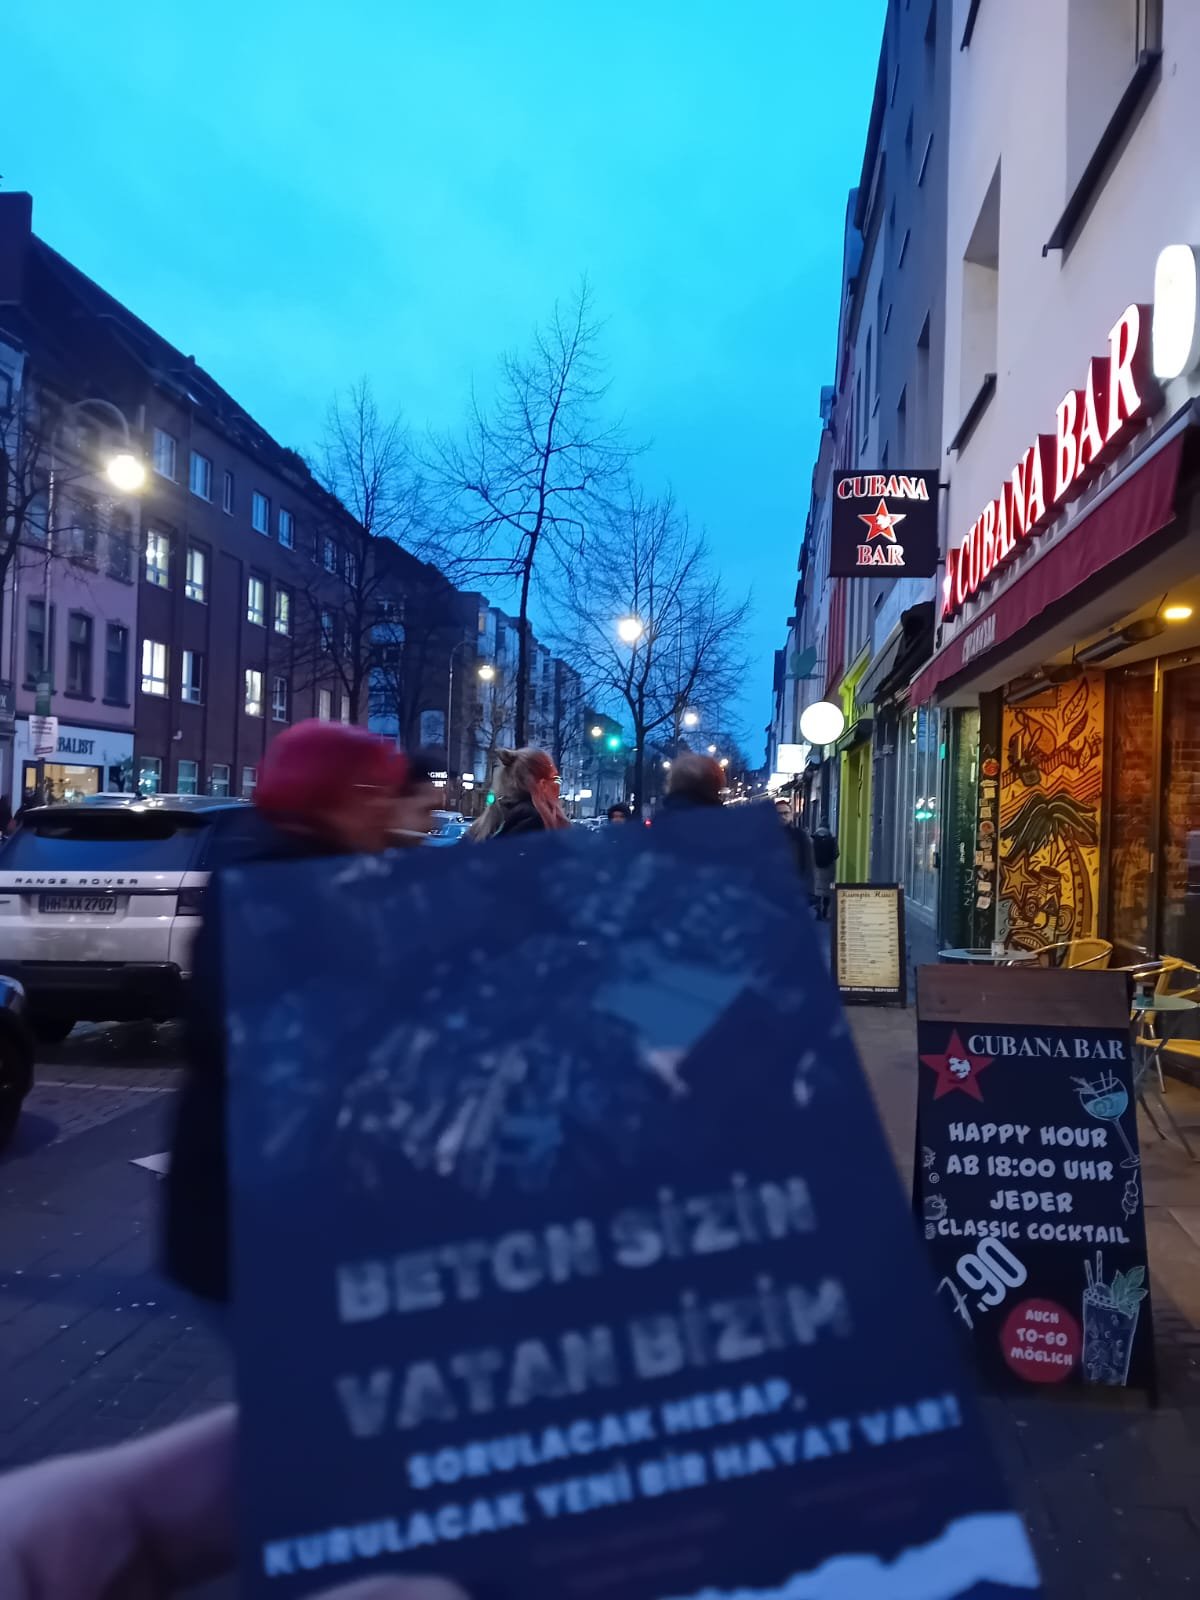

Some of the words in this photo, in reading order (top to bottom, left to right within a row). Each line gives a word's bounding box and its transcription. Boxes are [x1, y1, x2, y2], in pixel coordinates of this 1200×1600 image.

[958, 436, 1046, 604] CUBANA
[1054, 302, 1142, 503] BAR
[837, 474, 930, 501] CUBANA
[856, 544, 905, 567] BAR
[57, 736, 95, 755] BALIST
[15, 877, 68, 885] RANGE
[968, 1034, 1071, 1058] CUBANA
[1074, 1038, 1126, 1060] BAR
[948, 1122, 1031, 1145] HAPPY
[1040, 1126, 1108, 1148] HOUR
[946, 1154, 980, 1175] AB
[987, 1155, 1056, 1178] 18:00
[1064, 1160, 1114, 1182] UHR
[990, 1190, 1073, 1214] JEDER
[938, 1218, 1020, 1239] CLASSIC
[1027, 1223, 1130, 1244] COCKTAIL
[1025, 1309, 1059, 1324] AUCH
[1016, 1328, 1068, 1347] TO-GO
[1011, 1346, 1073, 1366] MÖGLICH
[336, 1323, 620, 1441] VATAN
[406, 1402, 656, 1490] SORULACAK
[262, 1494, 529, 1577] KURULACAK
[713, 1418, 853, 1482] HAYAT
